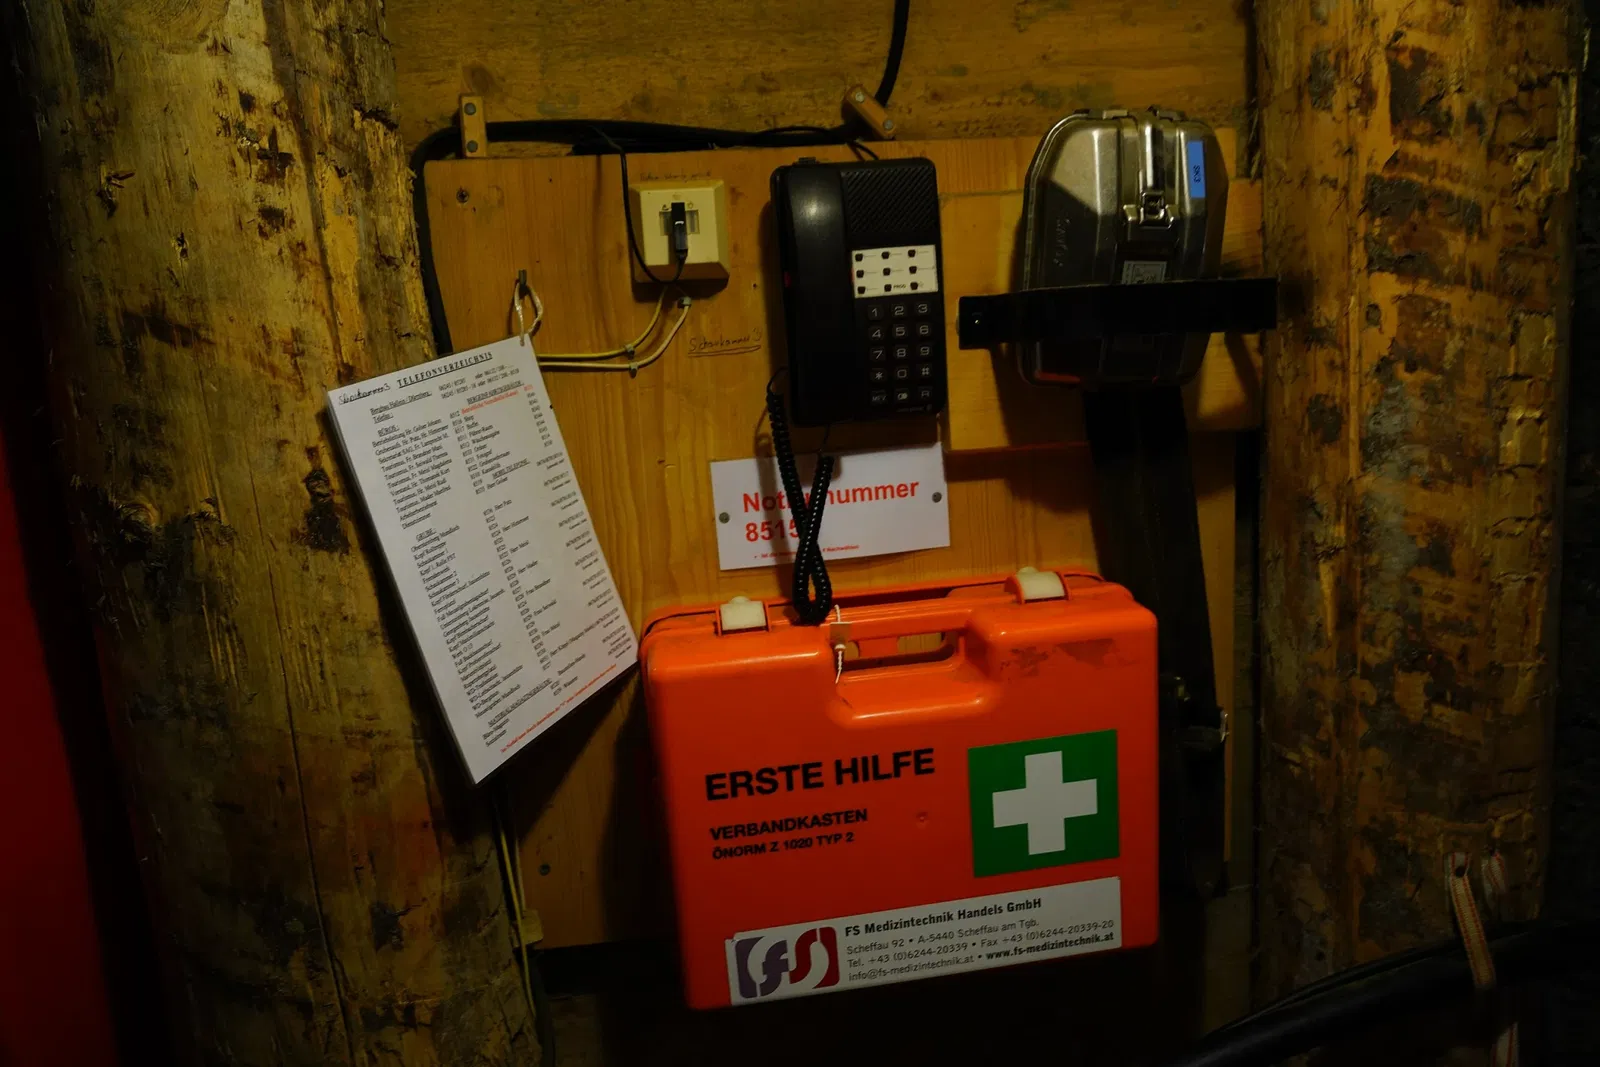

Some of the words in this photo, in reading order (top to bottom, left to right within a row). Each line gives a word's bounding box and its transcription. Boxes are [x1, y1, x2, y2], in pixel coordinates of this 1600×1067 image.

[871, 308, 878, 317] 1
[894, 305, 905, 316] 2
[918, 303, 928, 314] 3
[871, 329, 881, 338] 4
[895, 326, 906, 337] 5
[919, 324, 929, 335] 6
[397, 351, 493, 388] TELEFONVERZEICHNIS
[872, 350, 883, 360] 7
[896, 348, 906, 358] 8
[920, 346, 930, 356] 9
[742, 481, 919, 513] Notnummer
[705, 761, 824, 801] ERSTE
[834, 747, 935, 785] HILFE
[709, 808, 867, 841] VERBANDKASTEN
[712, 843, 766, 860] ÖNORM
[770, 841, 779, 852] Z
[783, 837, 813, 849] 1020
[815, 833, 843, 845] TYP
[845, 831, 854, 842] 2
[845, 925, 860, 937] FS
[864, 911, 954, 934] Medizintechnik
[957, 904, 1003, 920] Handels
[1006, 898, 1041, 912] GmbH
[846, 941, 889, 955] Scheffau
[891, 938, 904, 948] 92
[917, 931, 954, 944] A-5440
[957, 924, 999, 938] Scheffau
[1001, 922, 1016, 932] am
[1018, 918, 1039, 929] Tgb.
[846, 958, 864, 968] Tel.
[869, 954, 890, 963] +43
[893, 942, 968, 961] (0)6244-20339
[980, 938, 998, 947] Fax
[1002, 933, 1023, 943] +43
[1026, 919, 1114, 940] (0)6244-20339-20
[848, 955, 974, 981] info@fs-medizintechnik.at
[986, 931, 1114, 960] www.fs-medizintechnik.at
